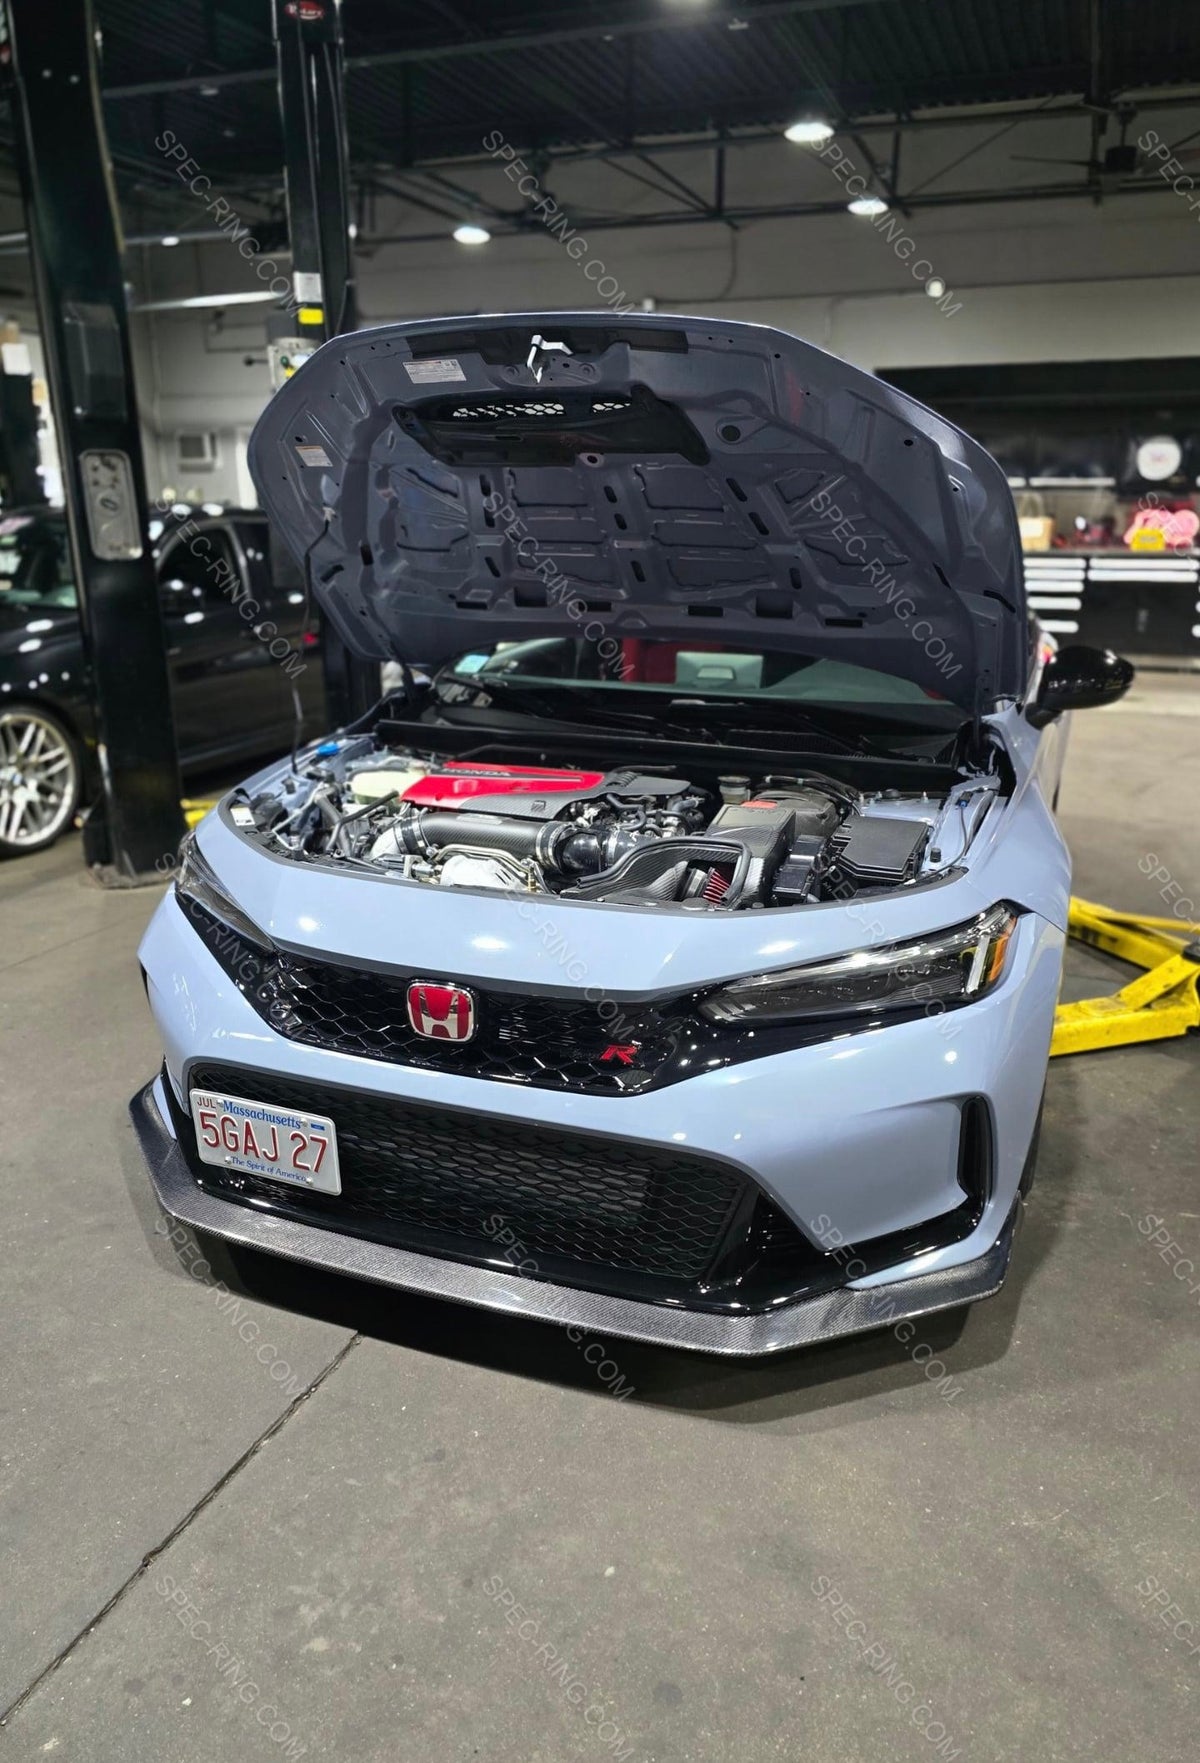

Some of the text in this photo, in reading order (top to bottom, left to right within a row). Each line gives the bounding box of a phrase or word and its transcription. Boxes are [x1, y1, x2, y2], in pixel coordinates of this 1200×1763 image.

[442, 768, 511, 777] HONDA
[197, 1096, 301, 1129] JUL Massachusetts
[200, 1111, 328, 1173] 5GAJ 27
[231, 1157, 306, 1182] The Spirit of America
